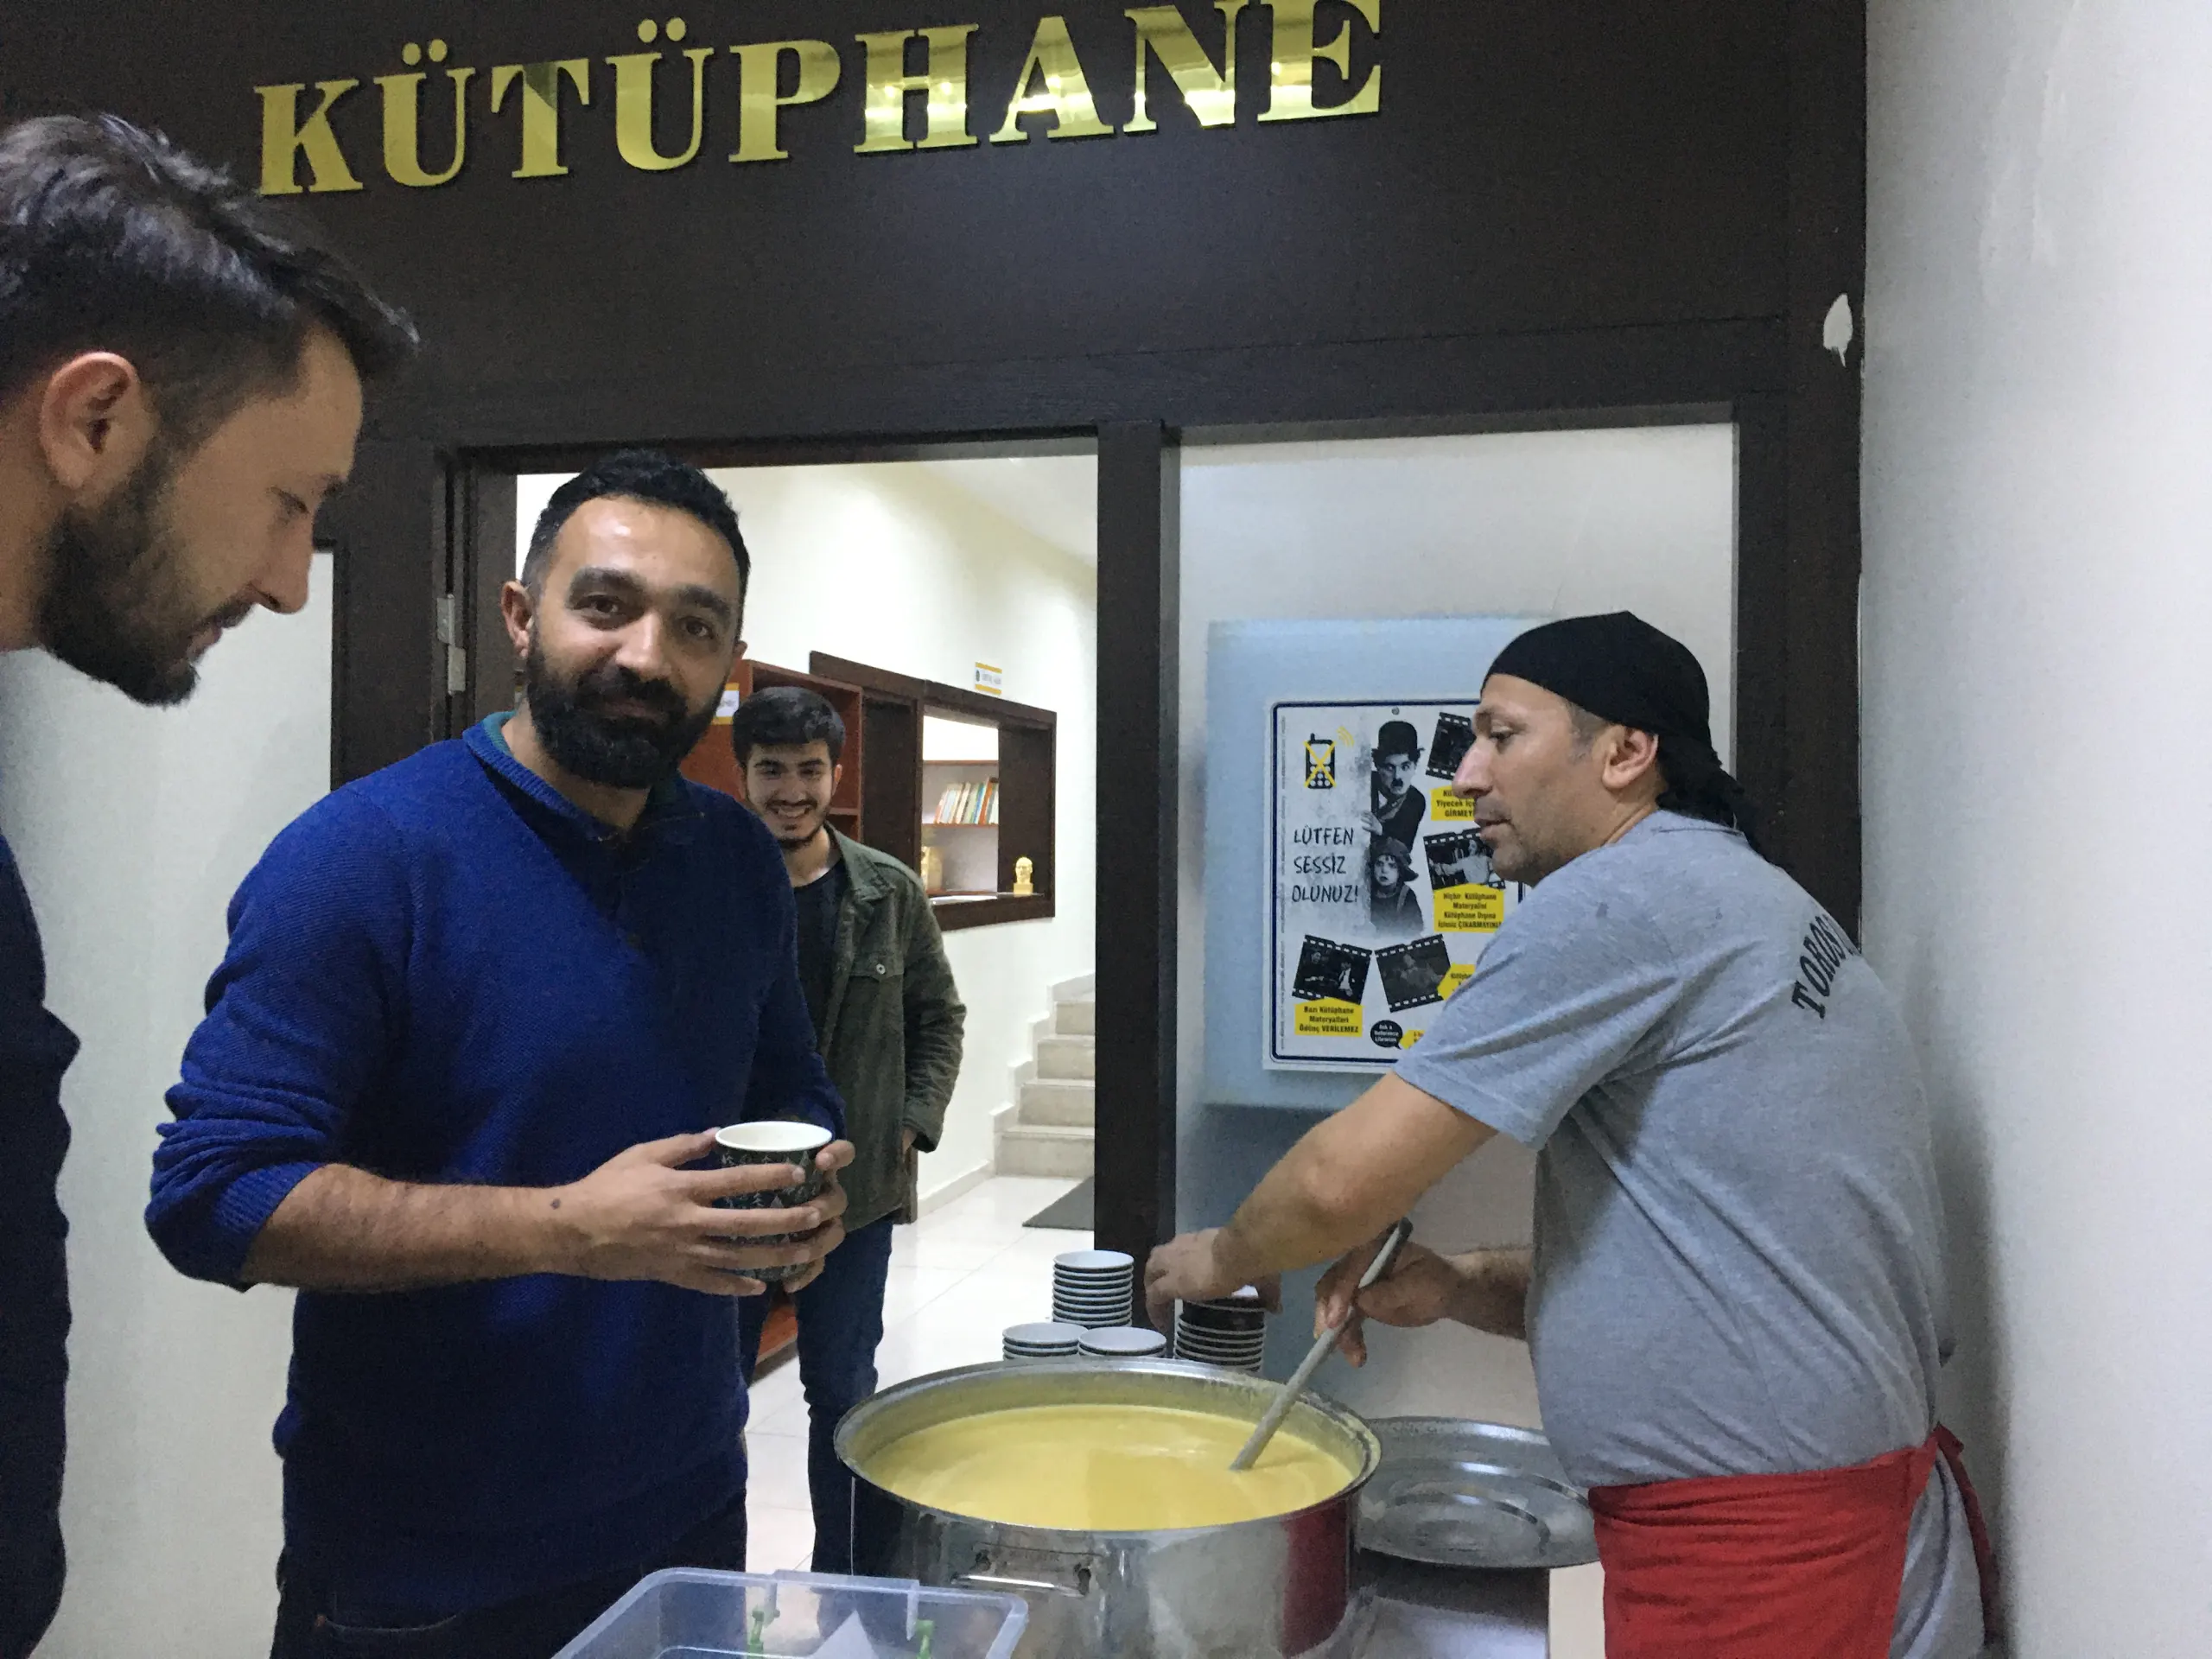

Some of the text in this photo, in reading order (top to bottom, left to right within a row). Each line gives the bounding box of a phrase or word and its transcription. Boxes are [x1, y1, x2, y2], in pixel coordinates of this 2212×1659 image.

[254, 0, 1381, 195] KÜTÜPHANE
[1445, 807, 1472, 817] GİRMEY
[1294, 823, 1354, 845] LÜTFEN
[1294, 852, 1346, 874] SESSİZ
[1292, 884, 1358, 903] OLUNUZ!
[1791, 913, 1855, 1020] TORON
